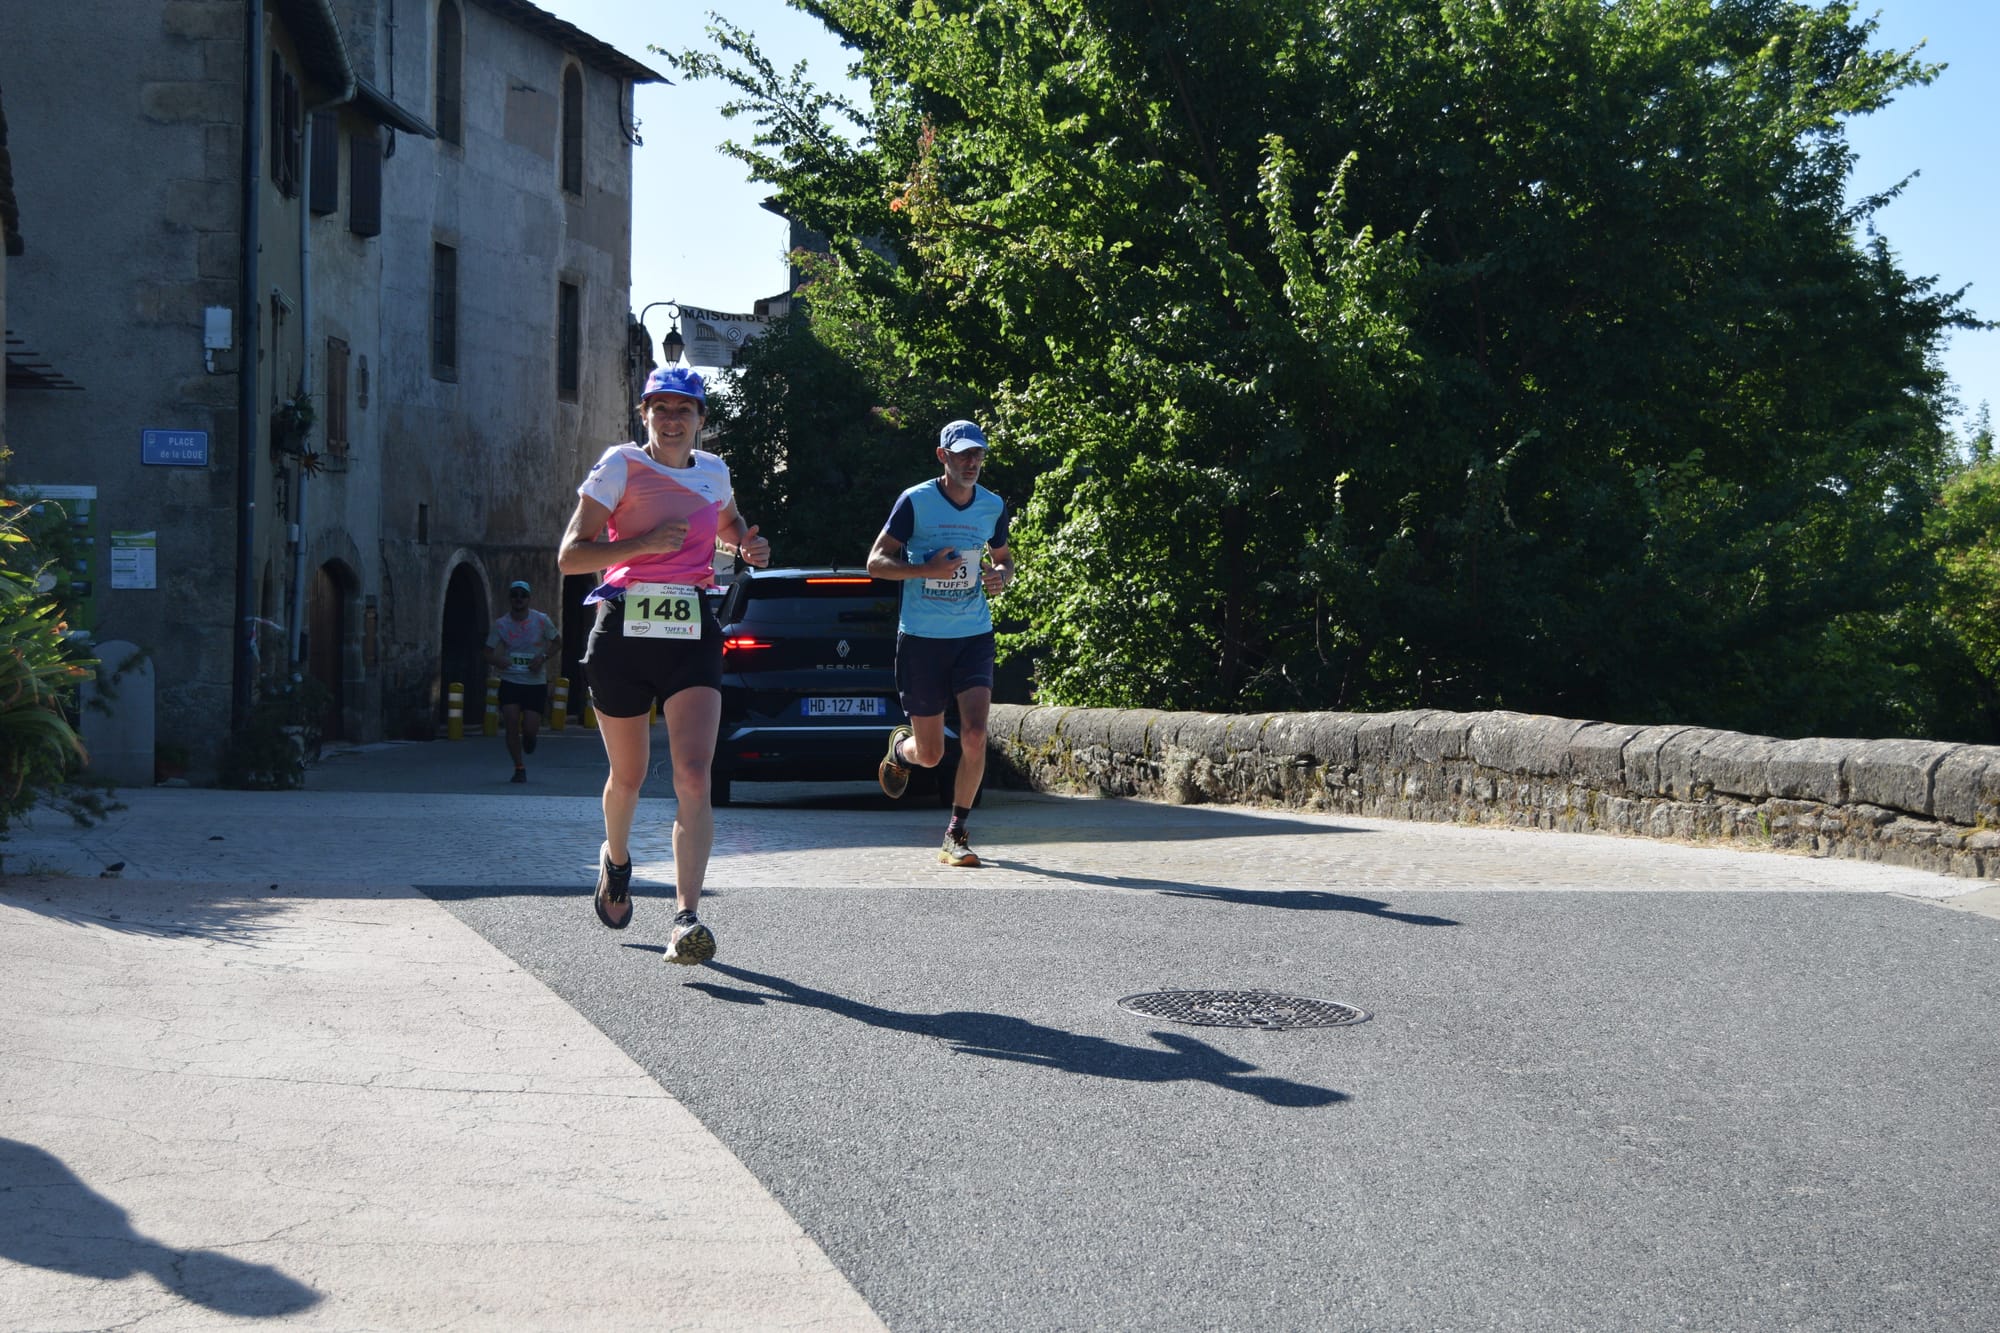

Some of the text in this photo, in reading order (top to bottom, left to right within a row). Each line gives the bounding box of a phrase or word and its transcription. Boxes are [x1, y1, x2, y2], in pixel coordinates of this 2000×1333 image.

[683, 309, 764, 323] MAISON DE
[168, 437, 195, 446] PLACE
[160, 450, 203, 459] de la LOUE
[936, 580, 969, 588] TUFF'S
[637, 598, 691, 621] 148
[810, 699, 874, 712] HD-127-AH
